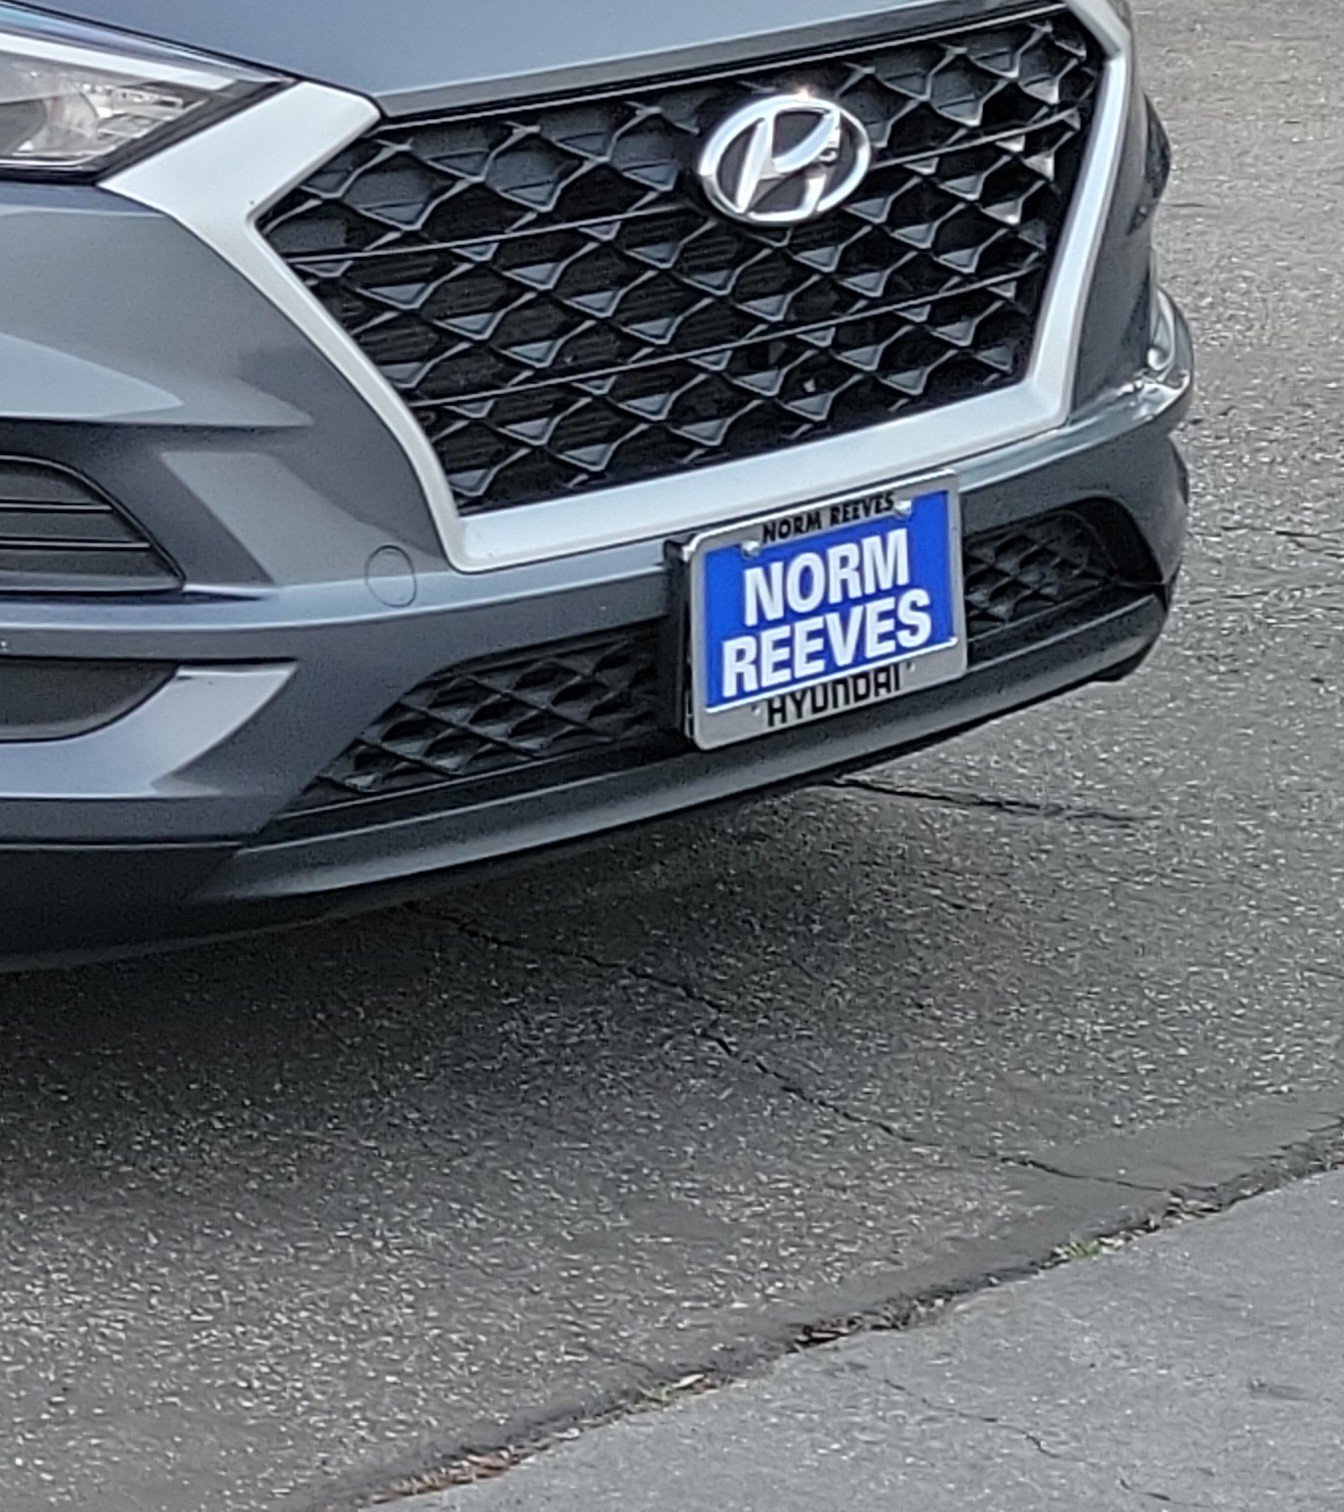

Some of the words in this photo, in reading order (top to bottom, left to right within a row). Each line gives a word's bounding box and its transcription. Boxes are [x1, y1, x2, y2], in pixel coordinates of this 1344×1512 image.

[762, 512, 823, 544] NORM
[829, 490, 895, 526] REEVES
[743, 528, 910, 628] NORM
[722, 587, 932, 699] REEVES
[767, 666, 901, 728] HYUNDAI
